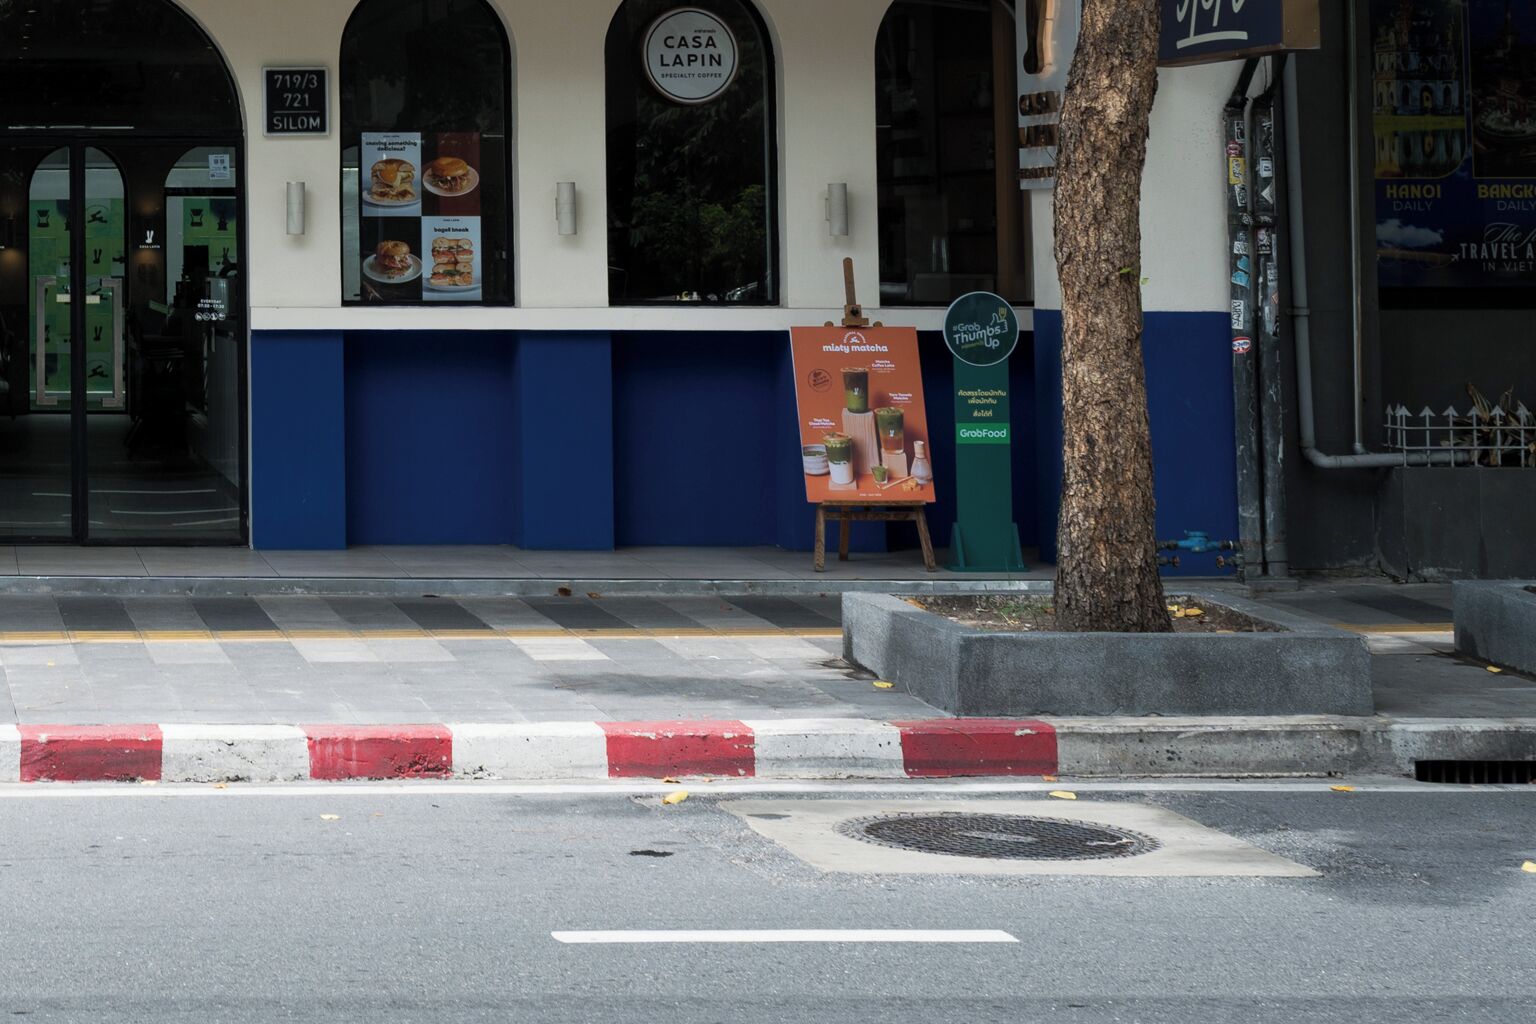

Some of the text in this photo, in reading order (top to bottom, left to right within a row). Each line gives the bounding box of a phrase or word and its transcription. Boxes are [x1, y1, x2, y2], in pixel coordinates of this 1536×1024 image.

[663, 35, 717, 49] CASA
[660, 53, 722, 67] LAPIN
[274, 72, 318, 89] 719/3
[283, 93, 309, 107] 721
[273, 116, 321, 130] SILOM
[388, 139, 418, 147] something
[1385, 184, 1442, 199] HANOI
[1477, 184, 1536, 199] BANGK
[1392, 200, 1433, 212] DAILY
[1496, 200, 1536, 211] DAILY
[1459, 242, 1518, 260] TRAVEL
[1482, 261, 1496, 273] IN
[952, 322, 981, 332] #Grab
[953, 325, 1001, 345] Thumbs
[822, 343, 889, 354] misty matcha
[984, 337, 1000, 350] Up
[959, 428, 1007, 438] GrabFood
